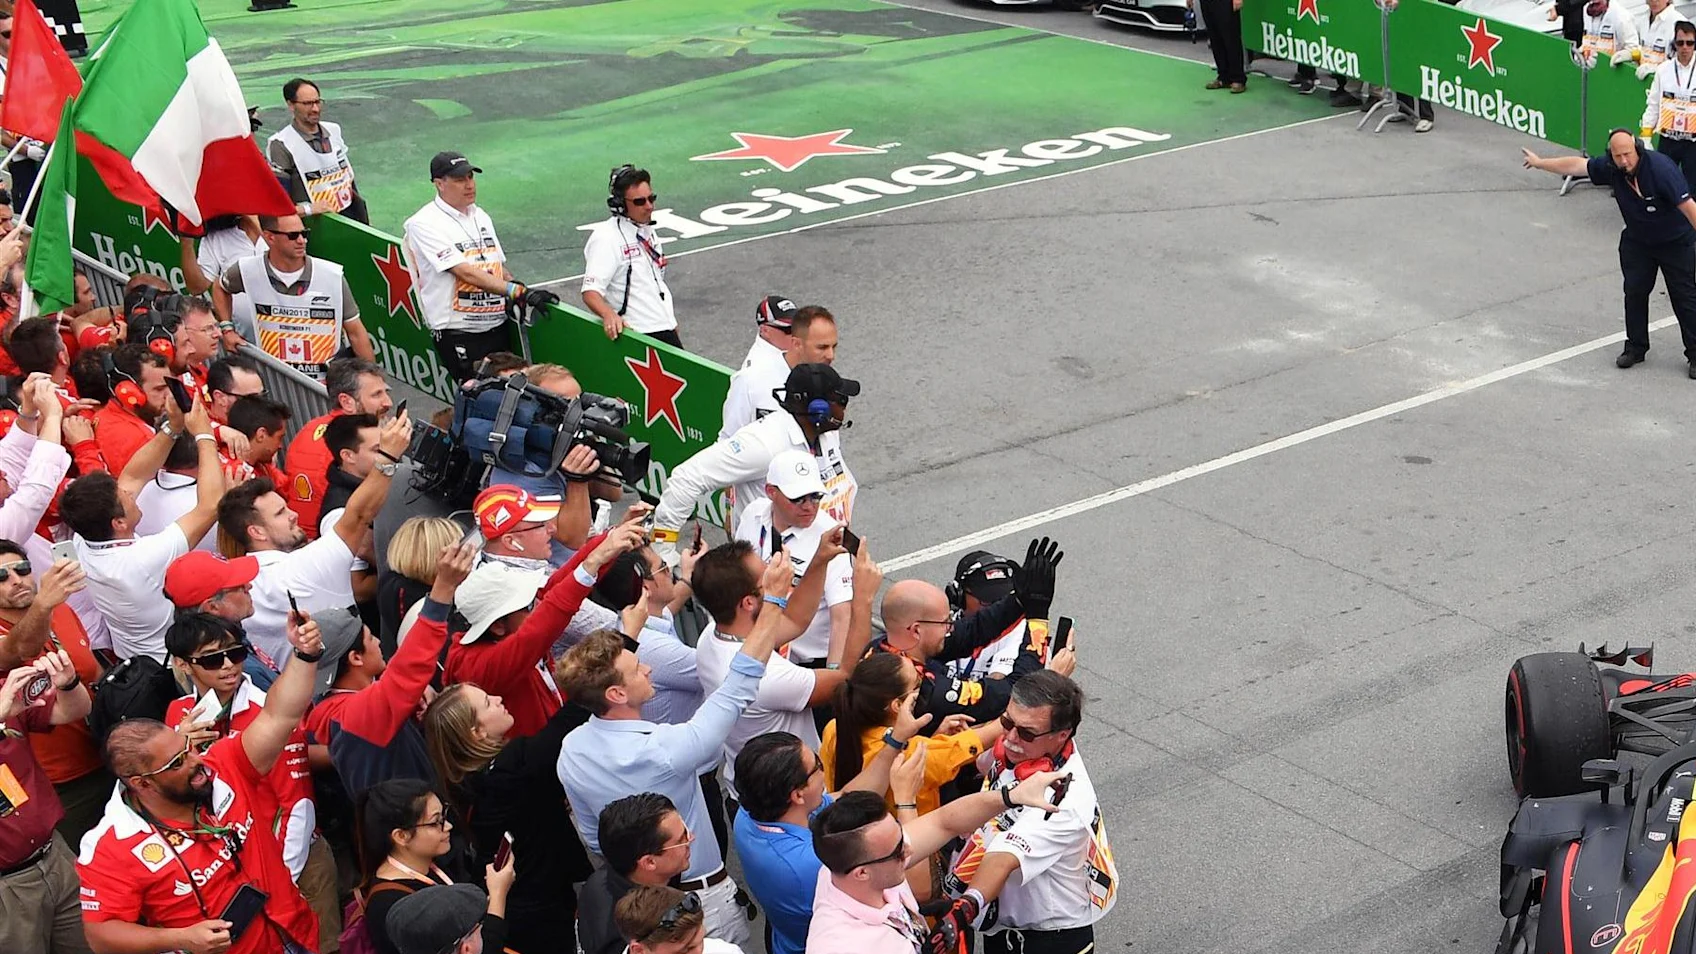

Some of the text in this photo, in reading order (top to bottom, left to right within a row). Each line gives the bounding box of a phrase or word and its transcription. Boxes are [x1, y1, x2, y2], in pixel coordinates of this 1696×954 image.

[1261, 21, 1361, 79] Heineken
[1420, 65, 1547, 139] Heineken
[90, 232, 188, 296] Heine
[272, 308, 308, 317] CAN2012
[368, 326, 459, 406] einek
[686, 426, 703, 443] 1873
[191, 811, 253, 887] Santder
